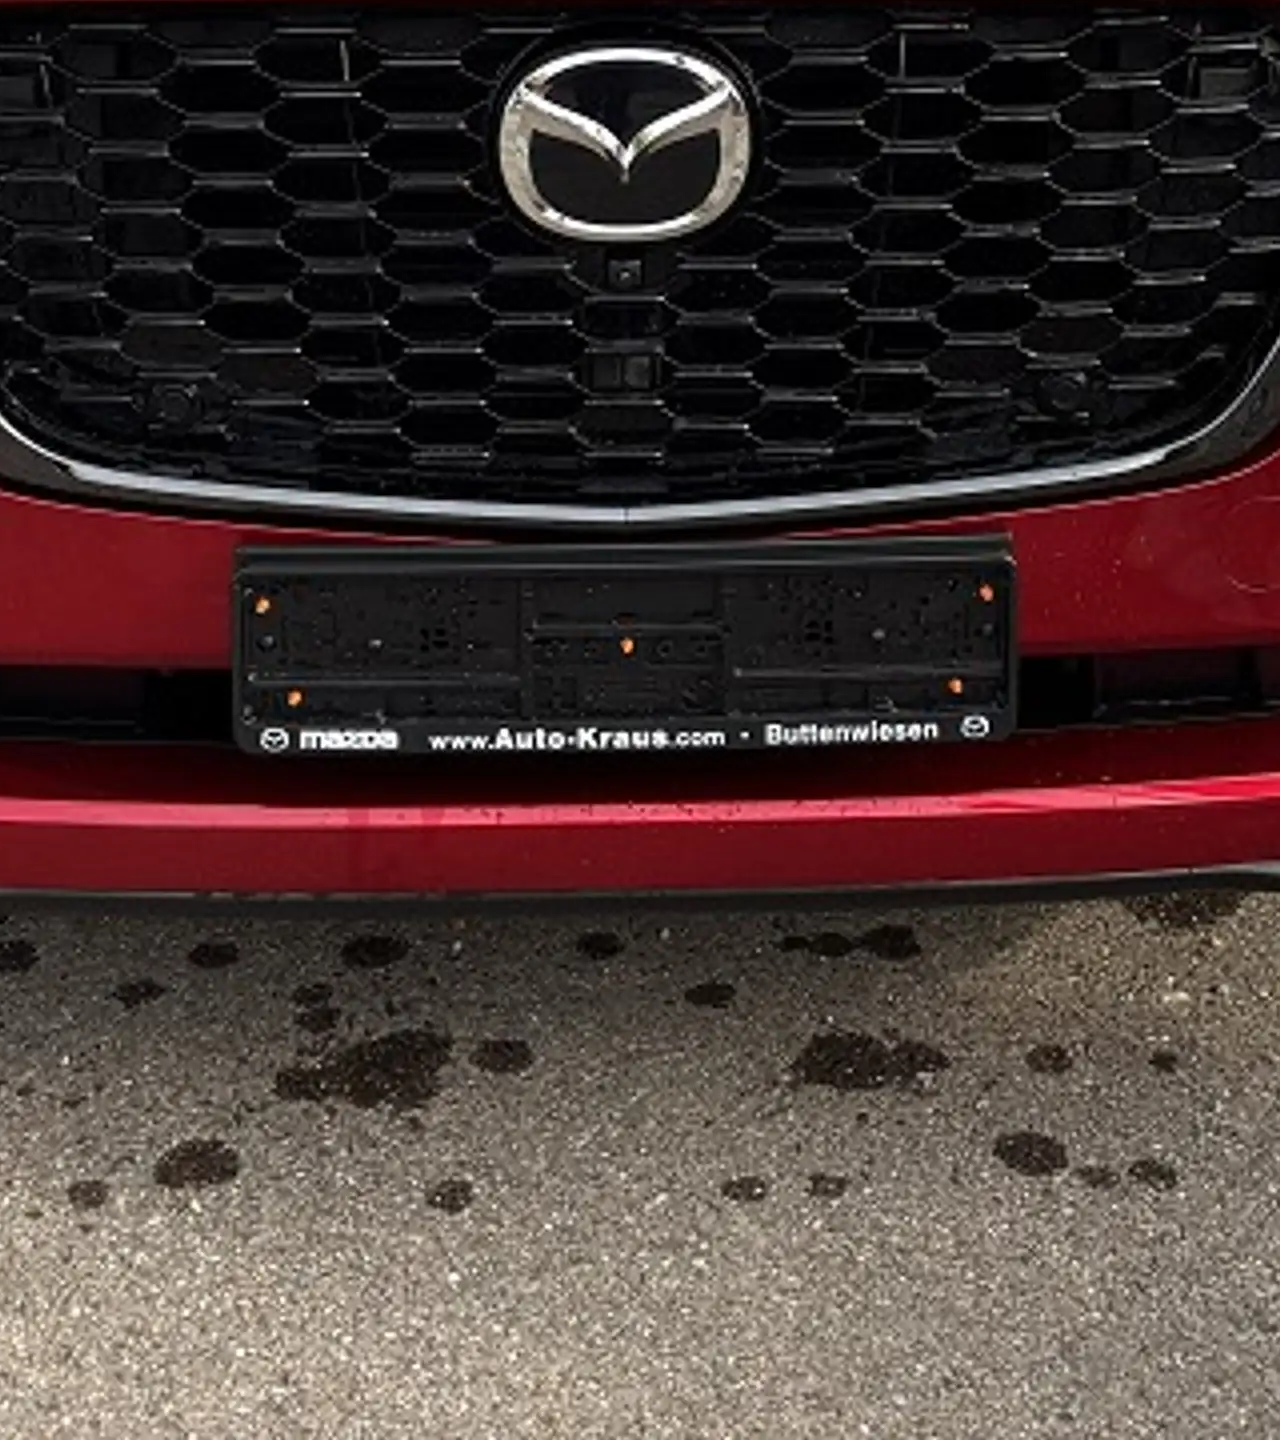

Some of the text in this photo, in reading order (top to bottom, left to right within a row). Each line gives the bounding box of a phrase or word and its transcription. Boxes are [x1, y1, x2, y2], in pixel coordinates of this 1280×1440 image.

[299, 719, 940, 751] mazda www.Auto-Kraus.com Buttenwiesen
